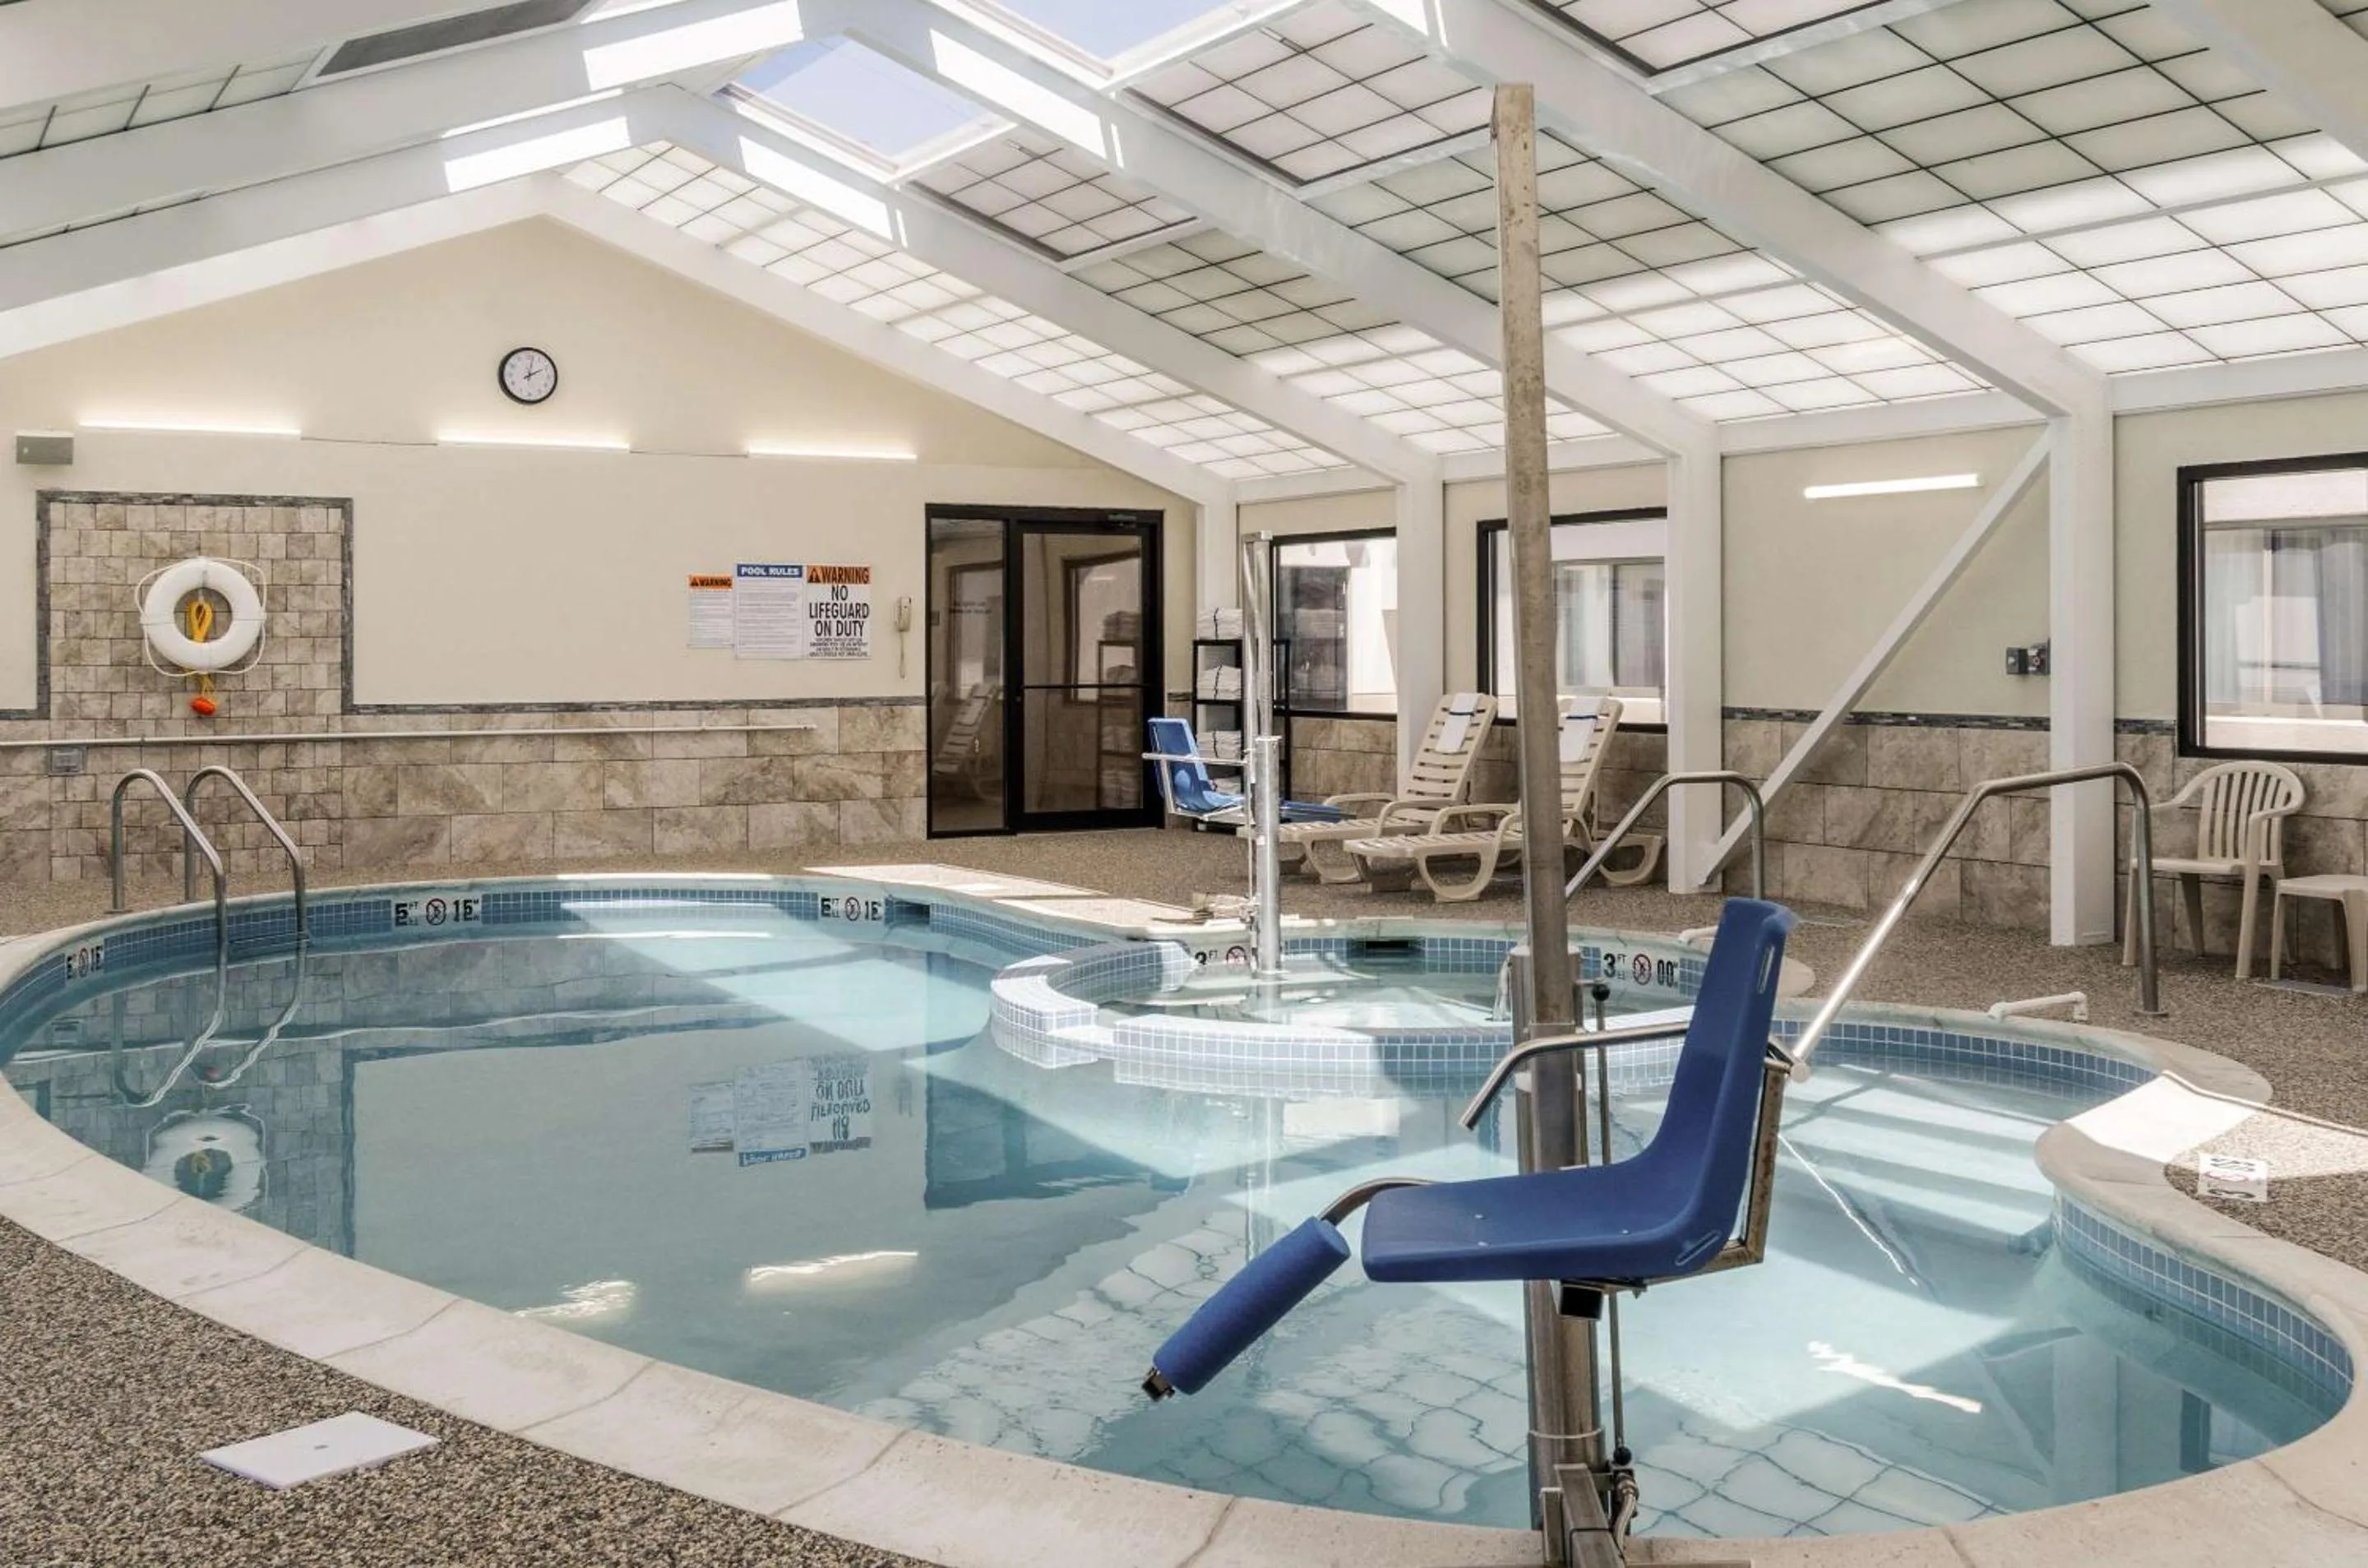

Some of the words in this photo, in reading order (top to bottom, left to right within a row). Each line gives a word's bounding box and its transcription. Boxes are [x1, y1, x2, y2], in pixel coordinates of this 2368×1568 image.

[741, 567, 765, 575] POOL
[768, 567, 798, 576] RULES
[821, 567, 870, 585] WARNING
[699, 577, 732, 587] WARNING
[831, 585, 848, 601] NO
[809, 603, 870, 618] LIFEGUARD
[815, 620, 831, 636] ON
[836, 620, 864, 636] DUTY
